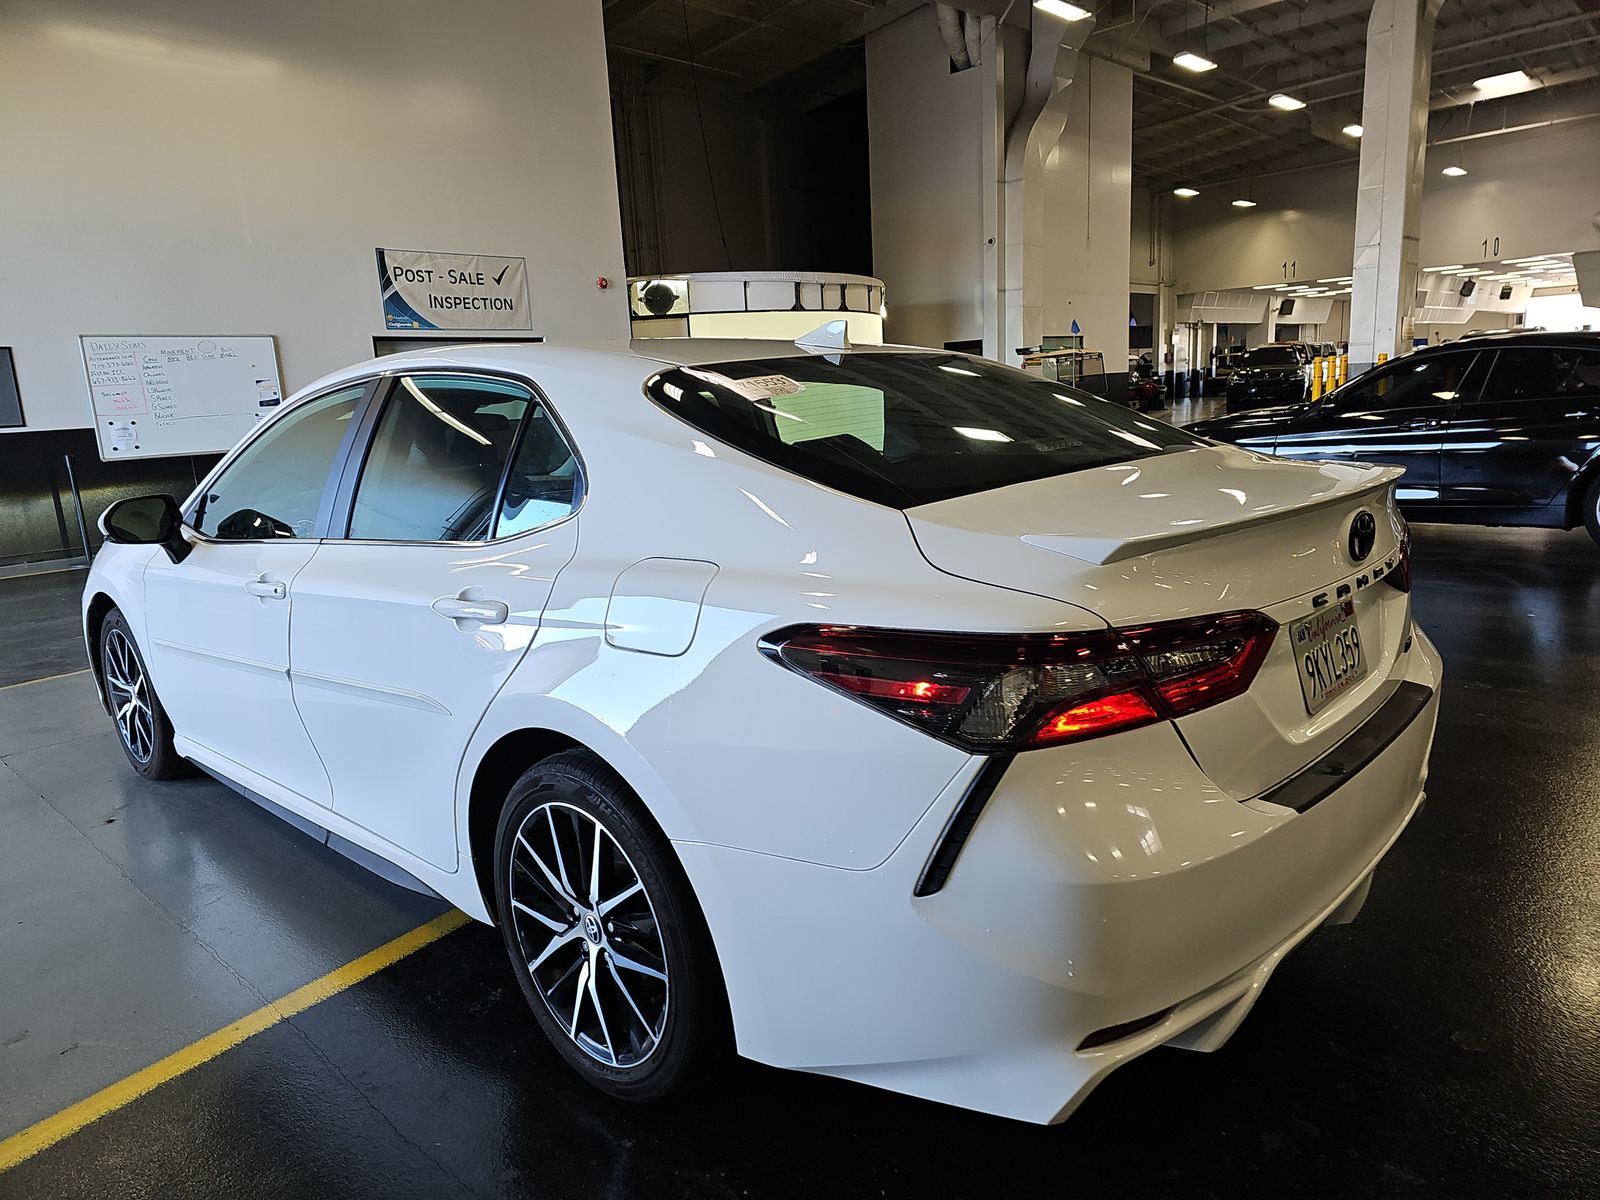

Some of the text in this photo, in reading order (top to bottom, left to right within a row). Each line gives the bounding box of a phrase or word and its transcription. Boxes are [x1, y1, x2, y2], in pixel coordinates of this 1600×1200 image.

[1482, 237, 1499, 258] 10
[1282, 260, 1296, 279] 11
[428, 293, 513, 311] INSPECTION
[1304, 626, 1361, 699] 9KYL359
